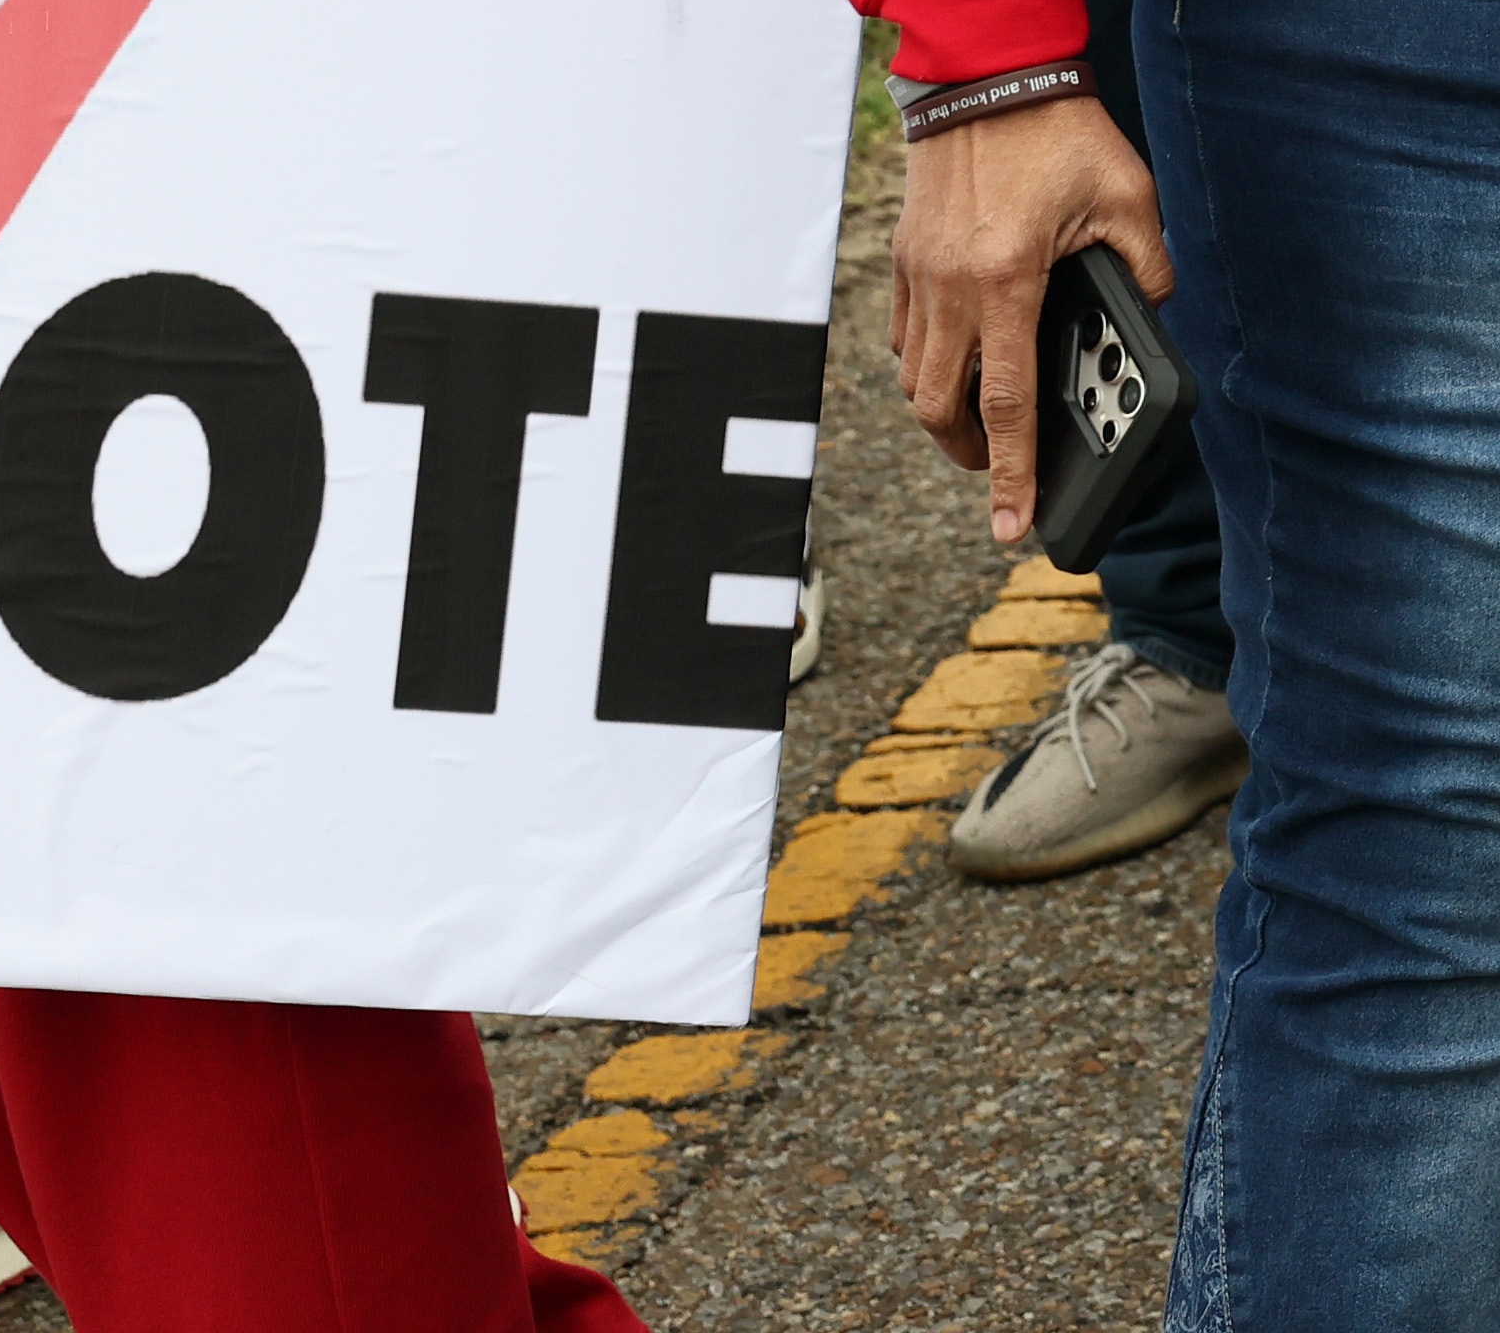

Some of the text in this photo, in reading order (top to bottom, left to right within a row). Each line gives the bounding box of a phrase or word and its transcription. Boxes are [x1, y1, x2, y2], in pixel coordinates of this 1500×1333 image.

[1060, 69, 1080, 85] Be
[951, 92, 988, 113] know
[989, 81, 1020, 103] and
[928, 101, 950, 123] that
